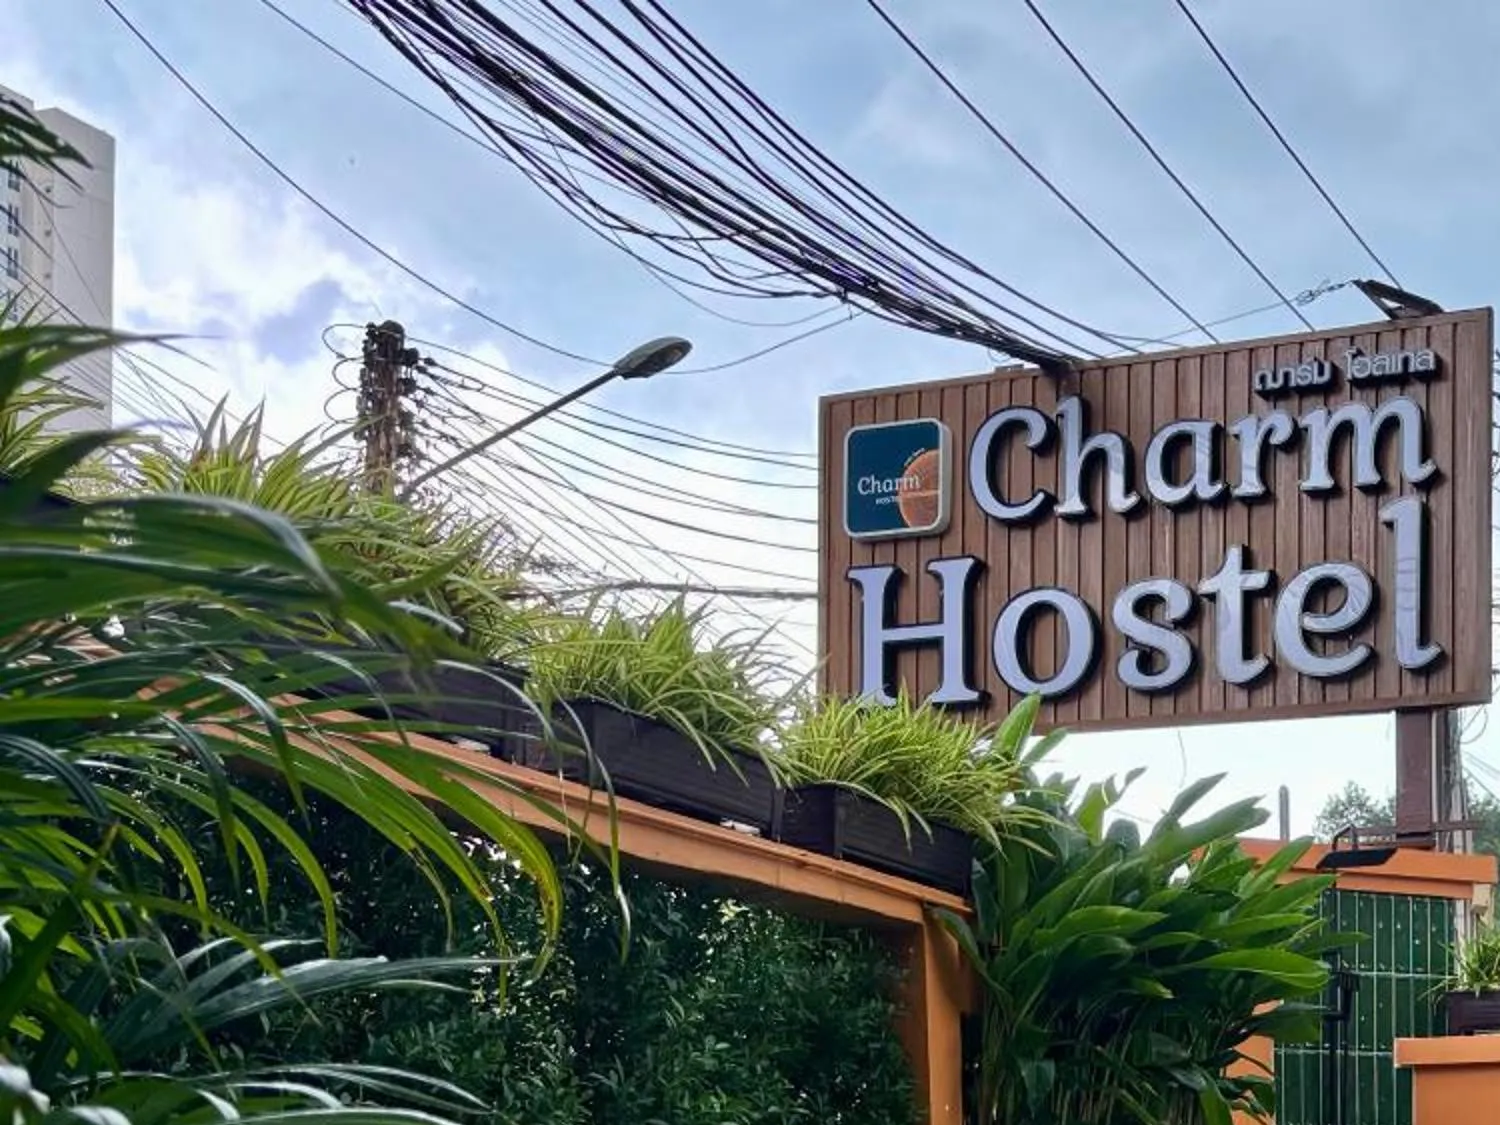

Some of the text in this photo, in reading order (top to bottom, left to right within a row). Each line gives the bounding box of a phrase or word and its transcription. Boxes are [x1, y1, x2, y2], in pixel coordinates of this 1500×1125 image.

[857, 474, 920, 496] Charm
[968, 395, 1438, 521] Charm
[846, 499, 1443, 708] Hostel
